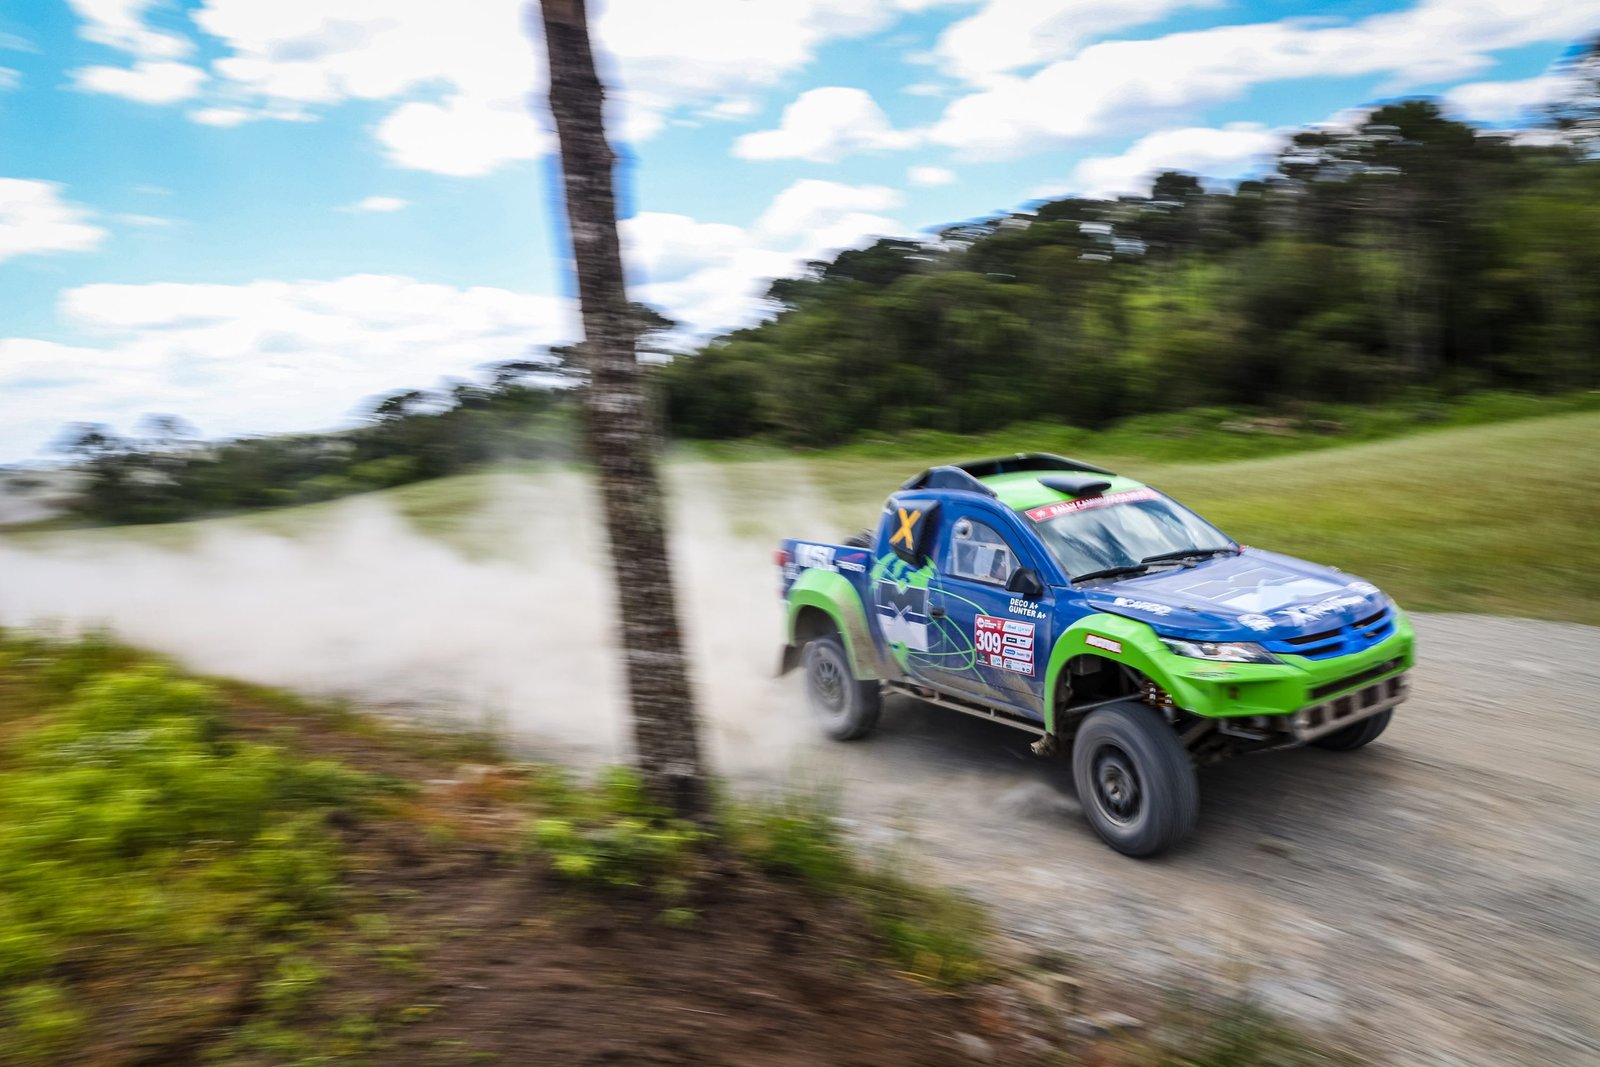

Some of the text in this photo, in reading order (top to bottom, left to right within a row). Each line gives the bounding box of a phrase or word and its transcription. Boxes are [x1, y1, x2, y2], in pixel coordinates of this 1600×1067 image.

[889, 508, 920, 550] X
[1009, 606, 1036, 617] GUNTER
[1010, 598, 1028, 608] DECO
[976, 630, 1001, 654] 309
